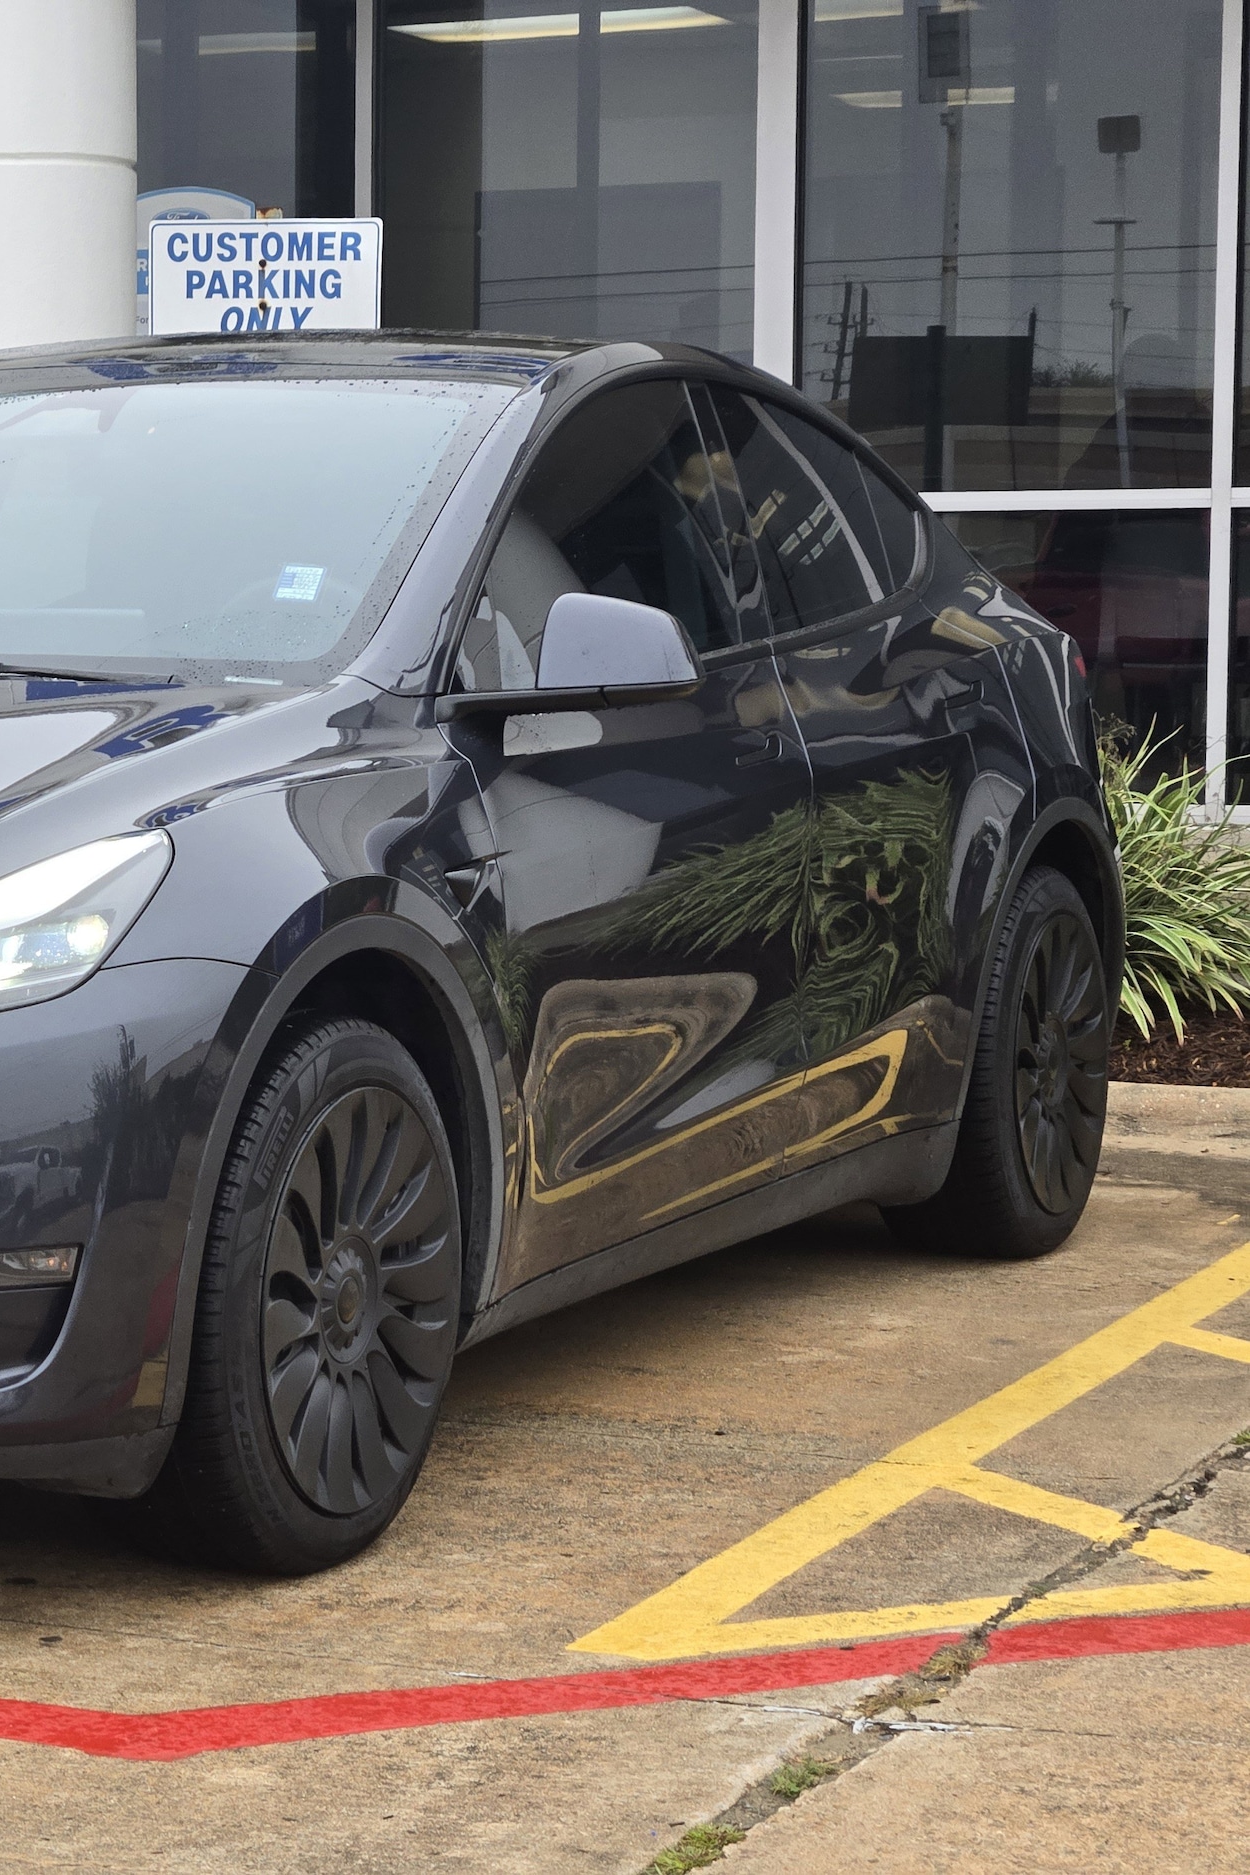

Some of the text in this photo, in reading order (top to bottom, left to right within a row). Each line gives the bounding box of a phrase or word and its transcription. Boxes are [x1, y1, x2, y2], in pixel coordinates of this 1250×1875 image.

[167, 231, 362, 262] CUSTOMER
[186, 268, 342, 299] PARKING
[220, 306, 312, 332] ONLY
[253, 1105, 294, 1190] PIRELLI
